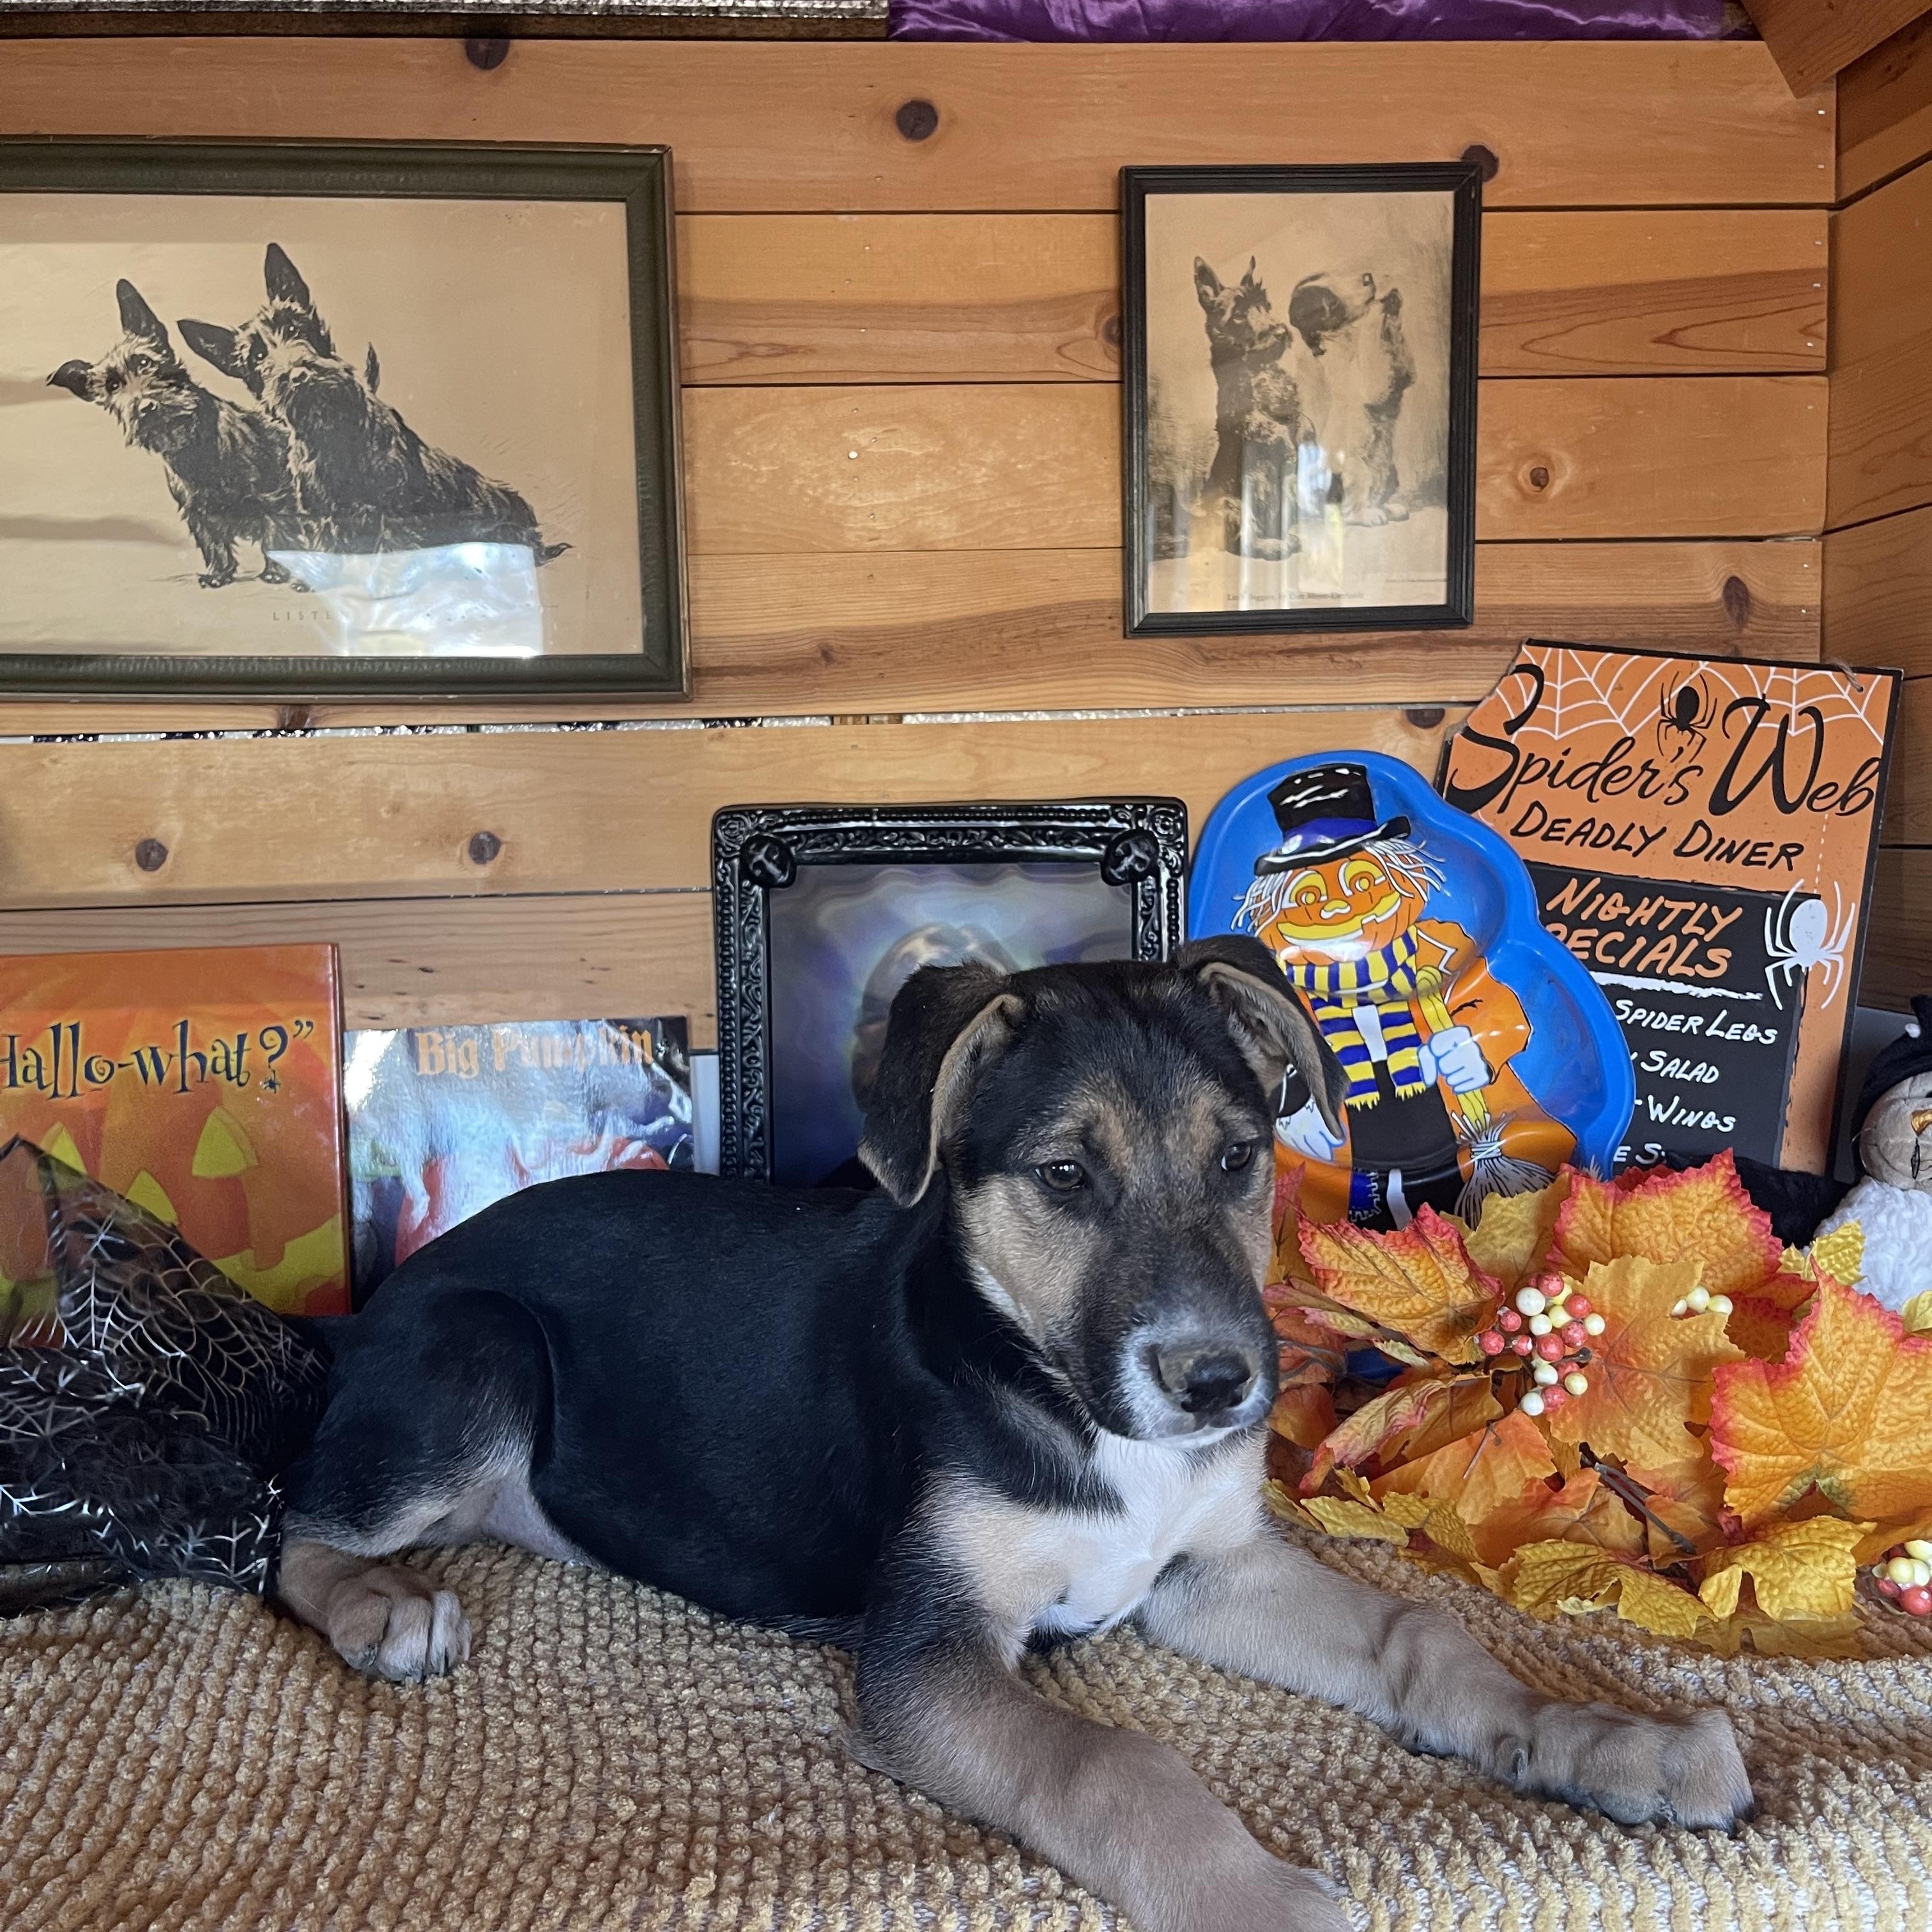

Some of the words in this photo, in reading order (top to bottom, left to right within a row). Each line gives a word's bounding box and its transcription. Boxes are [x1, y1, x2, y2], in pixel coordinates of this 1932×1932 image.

[273, 611, 333, 621] LISTE
[1446, 663, 1703, 814] Spider's
[1708, 693, 1880, 816] Web
[1510, 800, 1667, 857] DEADLY
[1673, 819, 1805, 872] DINER
[1545, 877, 1743, 942] NIGHTLY
[1545, 923, 1733, 979] PECIALS
[1614, 999, 1705, 1036] SPIDER
[1705, 1009, 1778, 1045] LEGS
[414, 1031, 479, 1080] Big
[1640, 1050, 1720, 1084] SALAD
[1647, 1094, 1736, 1133] WINGS
